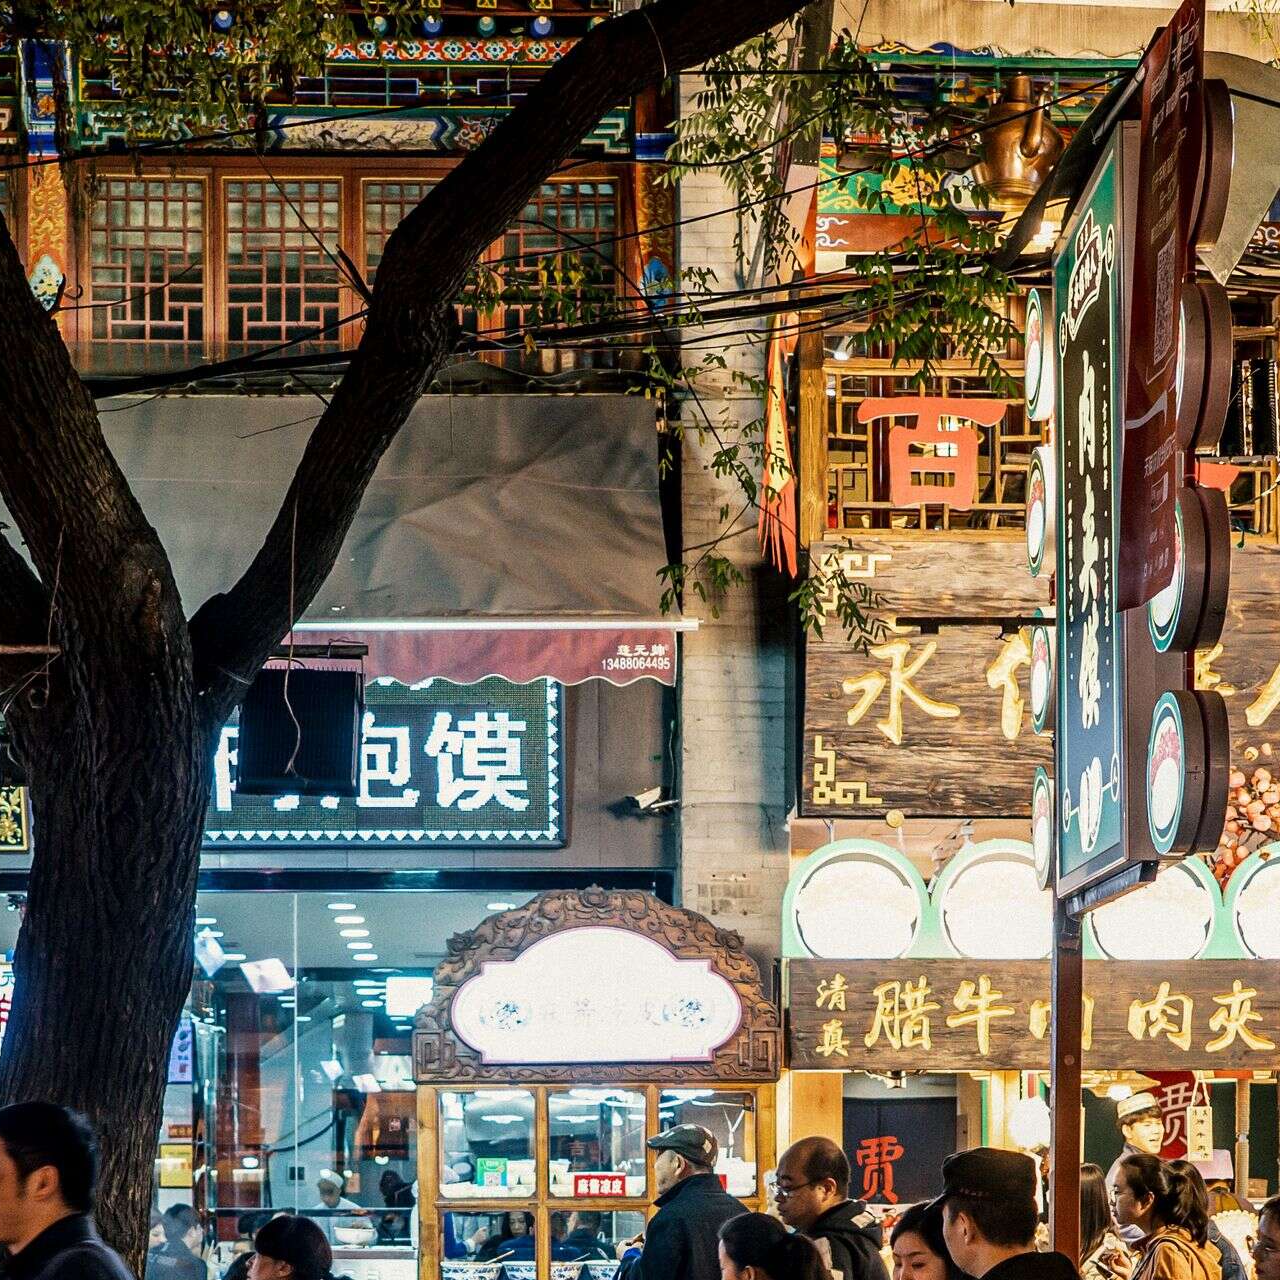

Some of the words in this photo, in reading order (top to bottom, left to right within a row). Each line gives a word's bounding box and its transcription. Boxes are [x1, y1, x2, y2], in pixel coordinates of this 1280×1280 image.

[601, 657, 671, 671] 13488064495
[815, 973, 849, 1059] 清真
[856, 1135, 905, 1204] 贾
